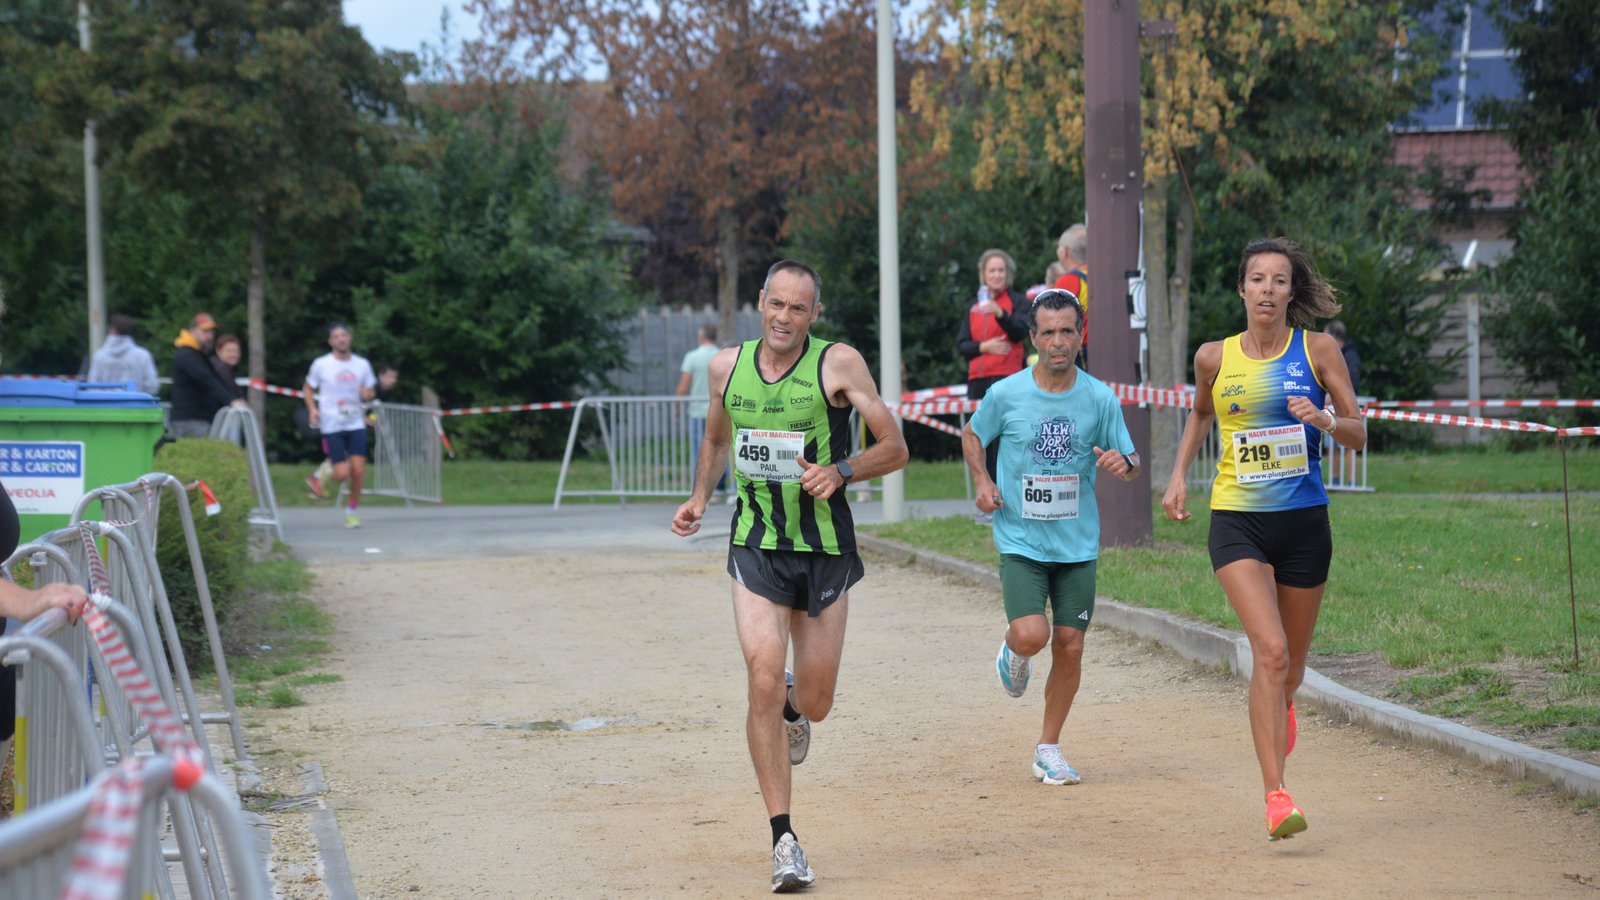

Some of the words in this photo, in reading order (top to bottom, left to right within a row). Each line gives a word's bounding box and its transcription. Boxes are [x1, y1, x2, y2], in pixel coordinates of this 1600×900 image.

[1041, 423, 1070, 435] NEW
[1268, 427, 1302, 436] MARATHON
[11, 448, 21, 459] &
[25, 449, 77, 460] KARTON
[739, 445, 770, 462] 459
[1043, 447, 1070, 458] CITY
[1239, 444, 1271, 463] 219
[11, 461, 21, 472] &
[25, 462, 77, 473] CARTON
[760, 464, 778, 472] PAUL
[1262, 461, 1282, 470] ELKE
[1249, 468, 1306, 480] www.plusprint.be
[1025, 488, 1052, 503] 605
[1032, 511, 1078, 519] www.plusprint.be
